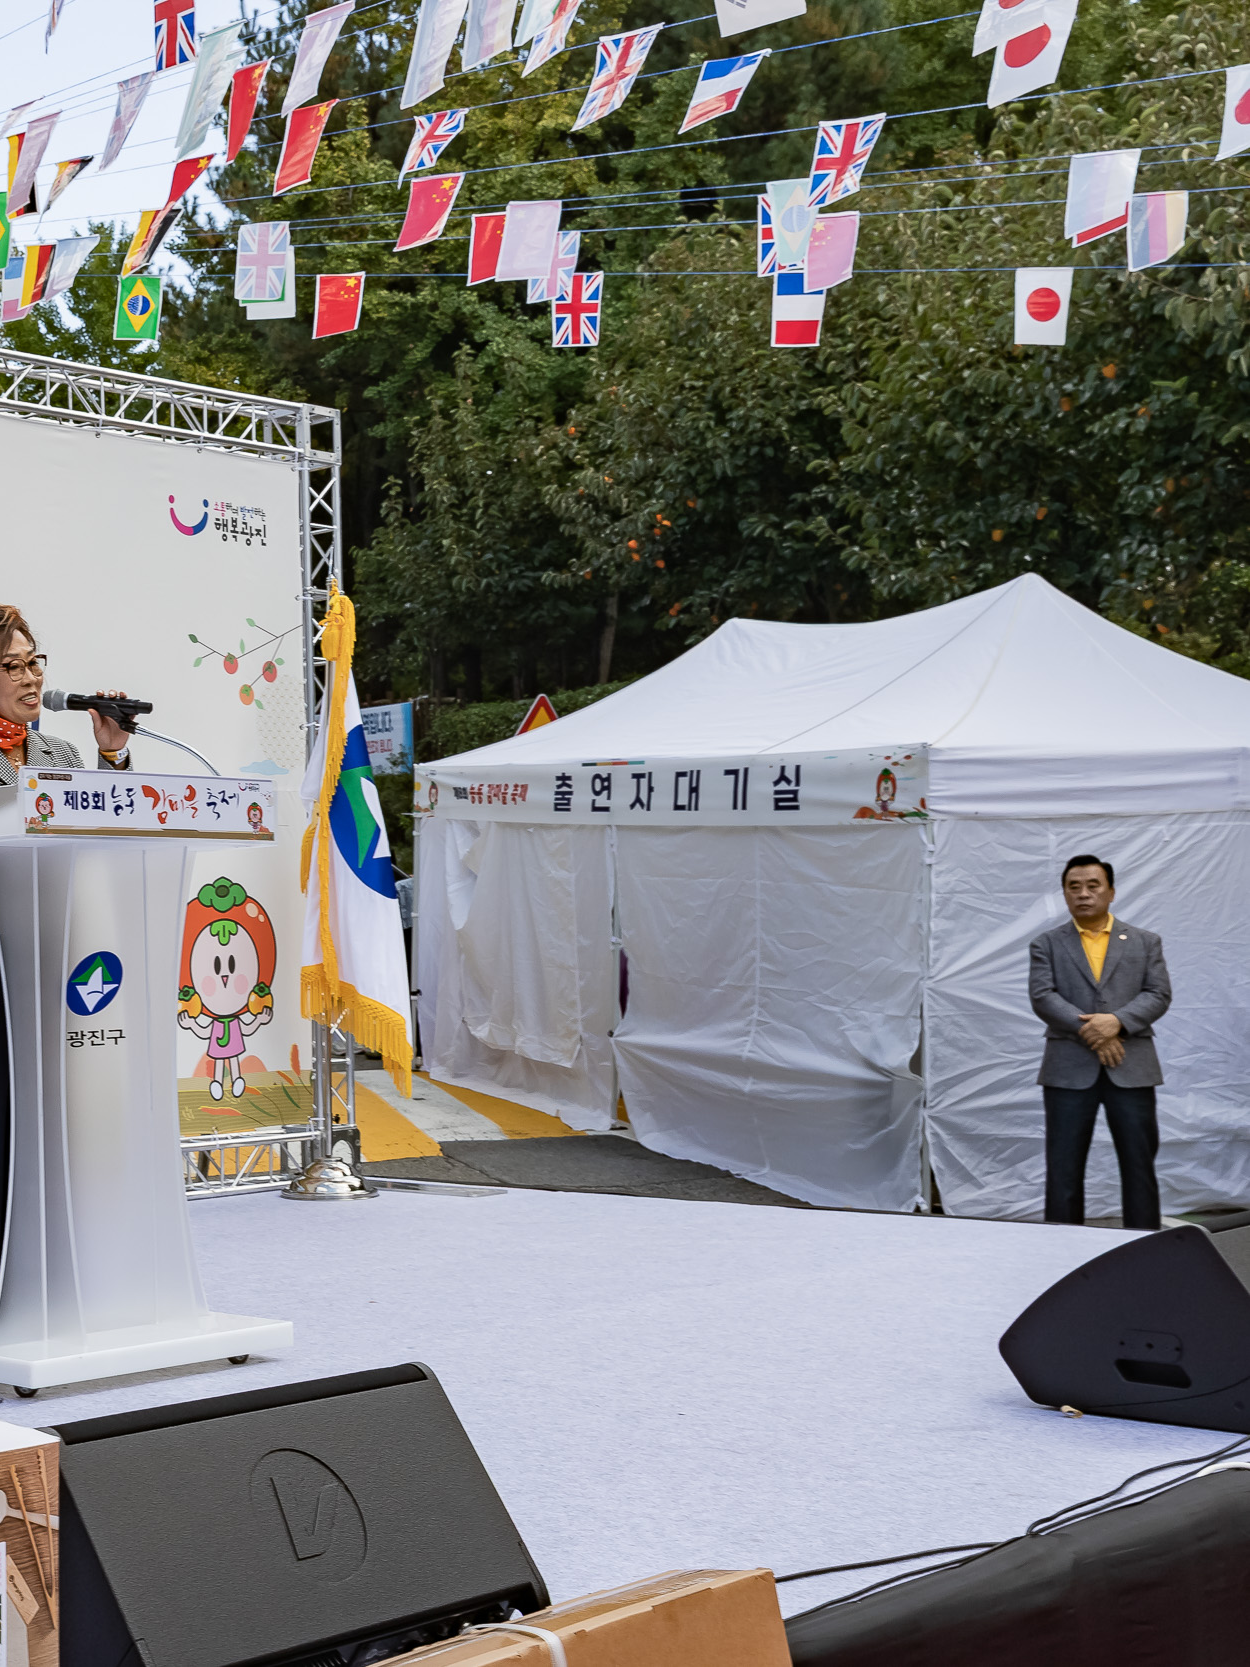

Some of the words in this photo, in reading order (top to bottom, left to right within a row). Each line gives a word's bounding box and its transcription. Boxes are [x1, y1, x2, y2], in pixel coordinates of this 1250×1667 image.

[214, 517, 266, 546] 행복광진
[64, 790, 105, 811] 제8회
[111, 784, 137, 816] 능동
[141, 784, 198, 824] 감마을
[206, 787, 240, 820] 축제
[66, 1029, 126, 1048] 광진구
